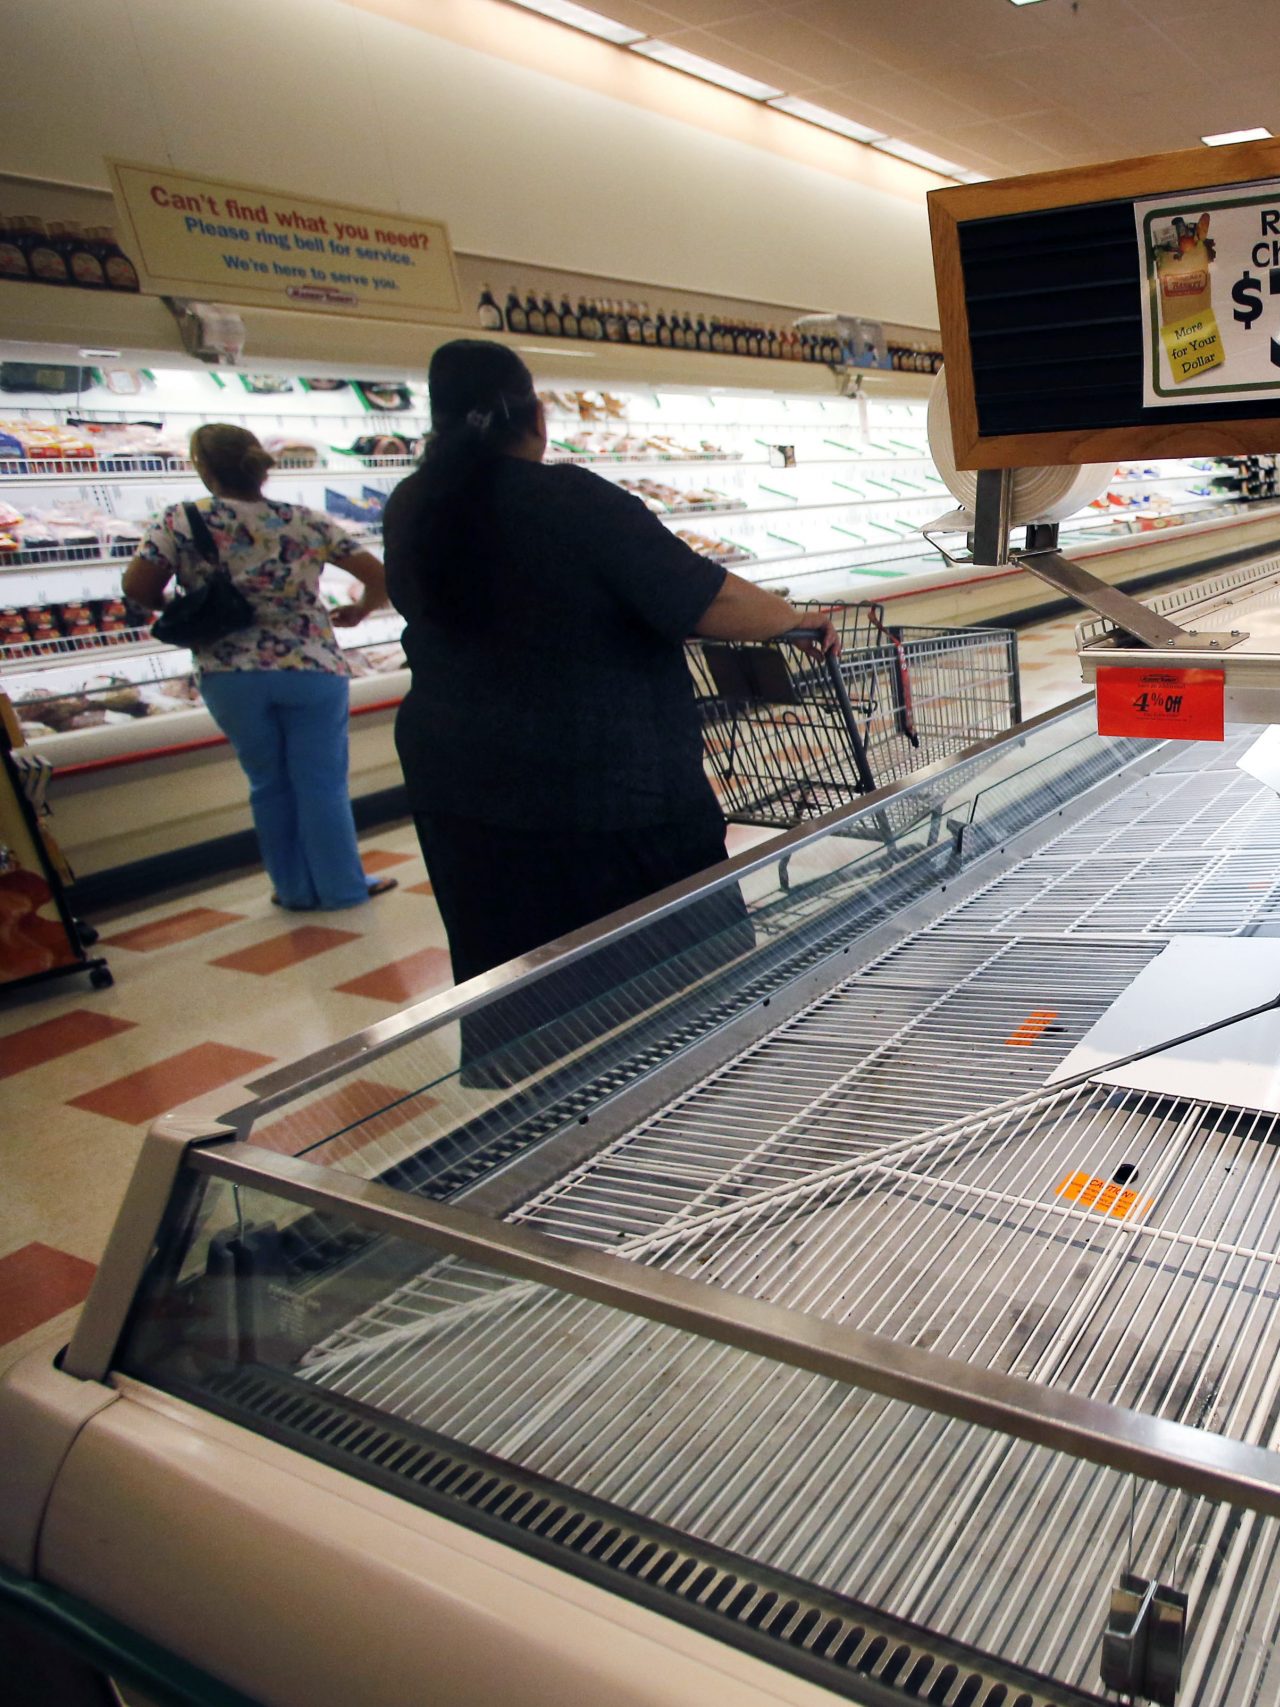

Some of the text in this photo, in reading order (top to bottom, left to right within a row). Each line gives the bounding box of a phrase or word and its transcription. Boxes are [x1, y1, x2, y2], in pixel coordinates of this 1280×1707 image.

[150, 185, 429, 250] Can't find what you need?
[185, 215, 415, 266] Please ring bell for service.
[222, 254, 399, 291] We're here to serve you.
[1174, 321, 1203, 340] More
[1172, 335, 1217, 360] for Your
[1182, 353, 1216, 374] Dollar
[1165, 695, 1183, 713] Off
